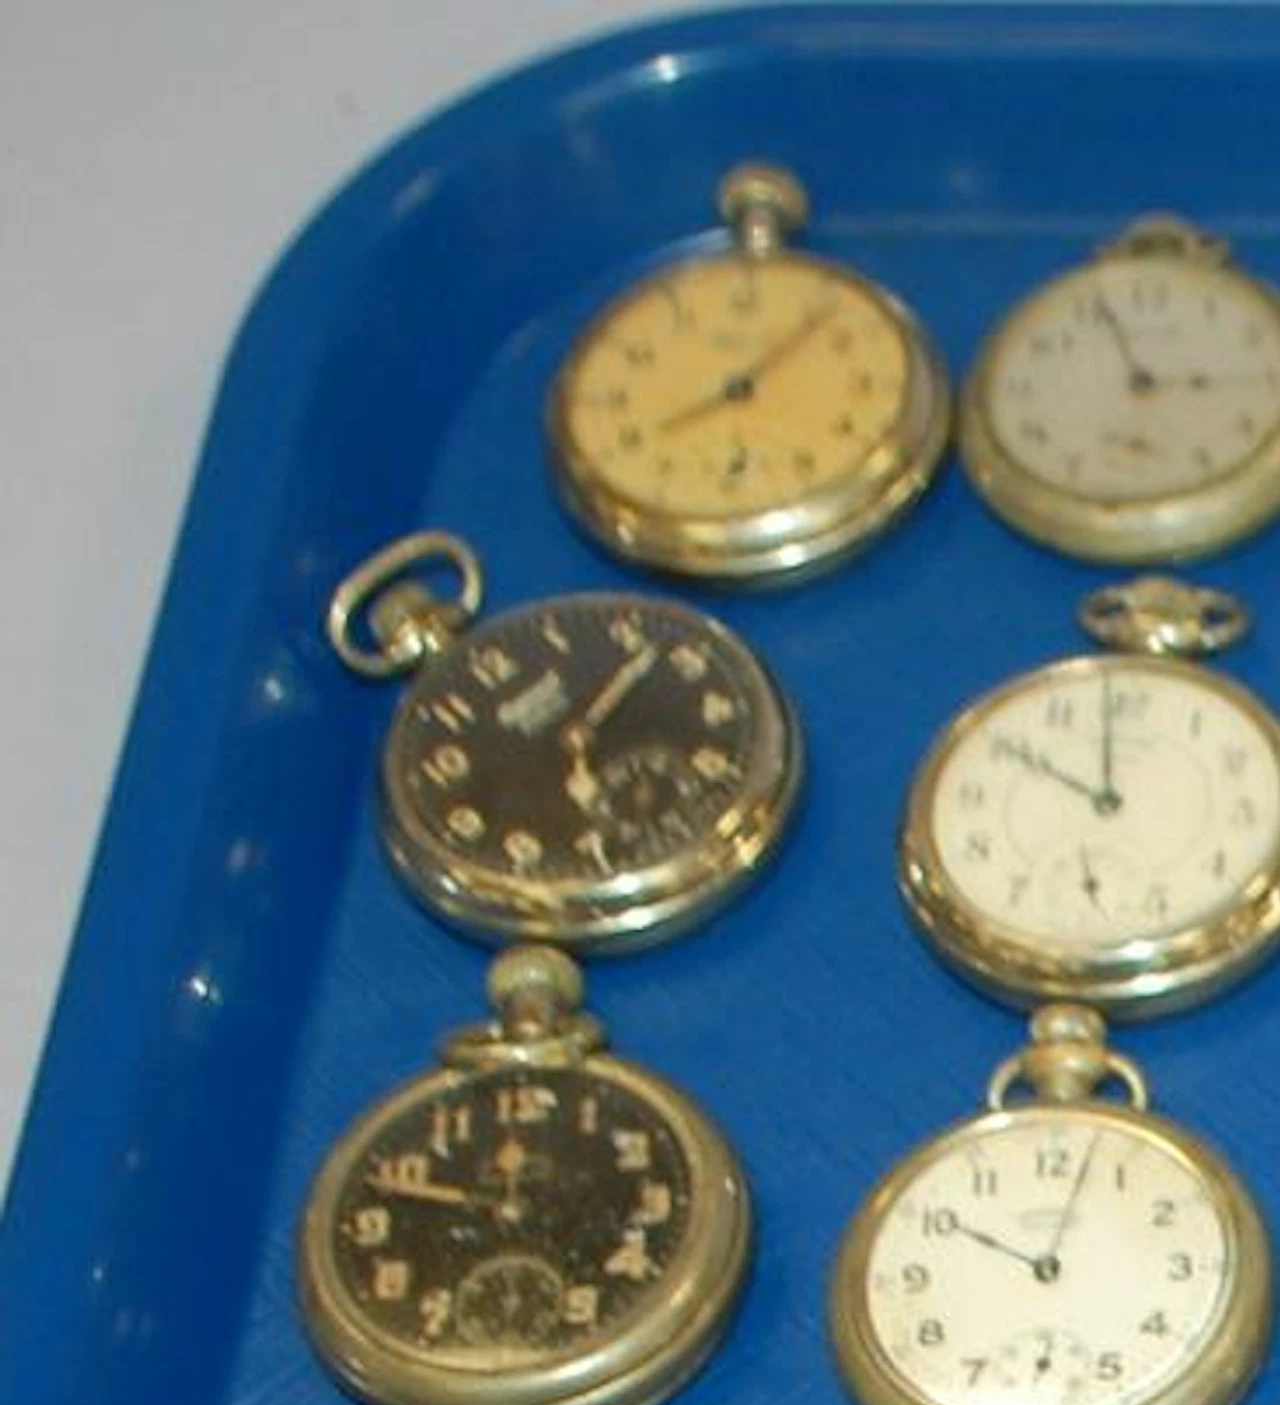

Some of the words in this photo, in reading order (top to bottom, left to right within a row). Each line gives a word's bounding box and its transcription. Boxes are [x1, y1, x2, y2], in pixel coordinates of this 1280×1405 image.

[421, 745, 471, 787] 10
[1036, 1150, 1069, 1178] 12
[1116, 1165, 1126, 1190] 1
[972, 1170, 998, 1195] 11
[923, 1209, 957, 1236] 10
[1151, 1200, 1175, 1227] 2
[605, 1227, 649, 1280] 4
[903, 1264, 929, 1292] 9
[1167, 1254, 1192, 1281] 3
[918, 1319, 944, 1345] 8
[1139, 1312, 1169, 1339] 4
[962, 1359, 989, 1386] 7
[1099, 1352, 1123, 1380] 5
